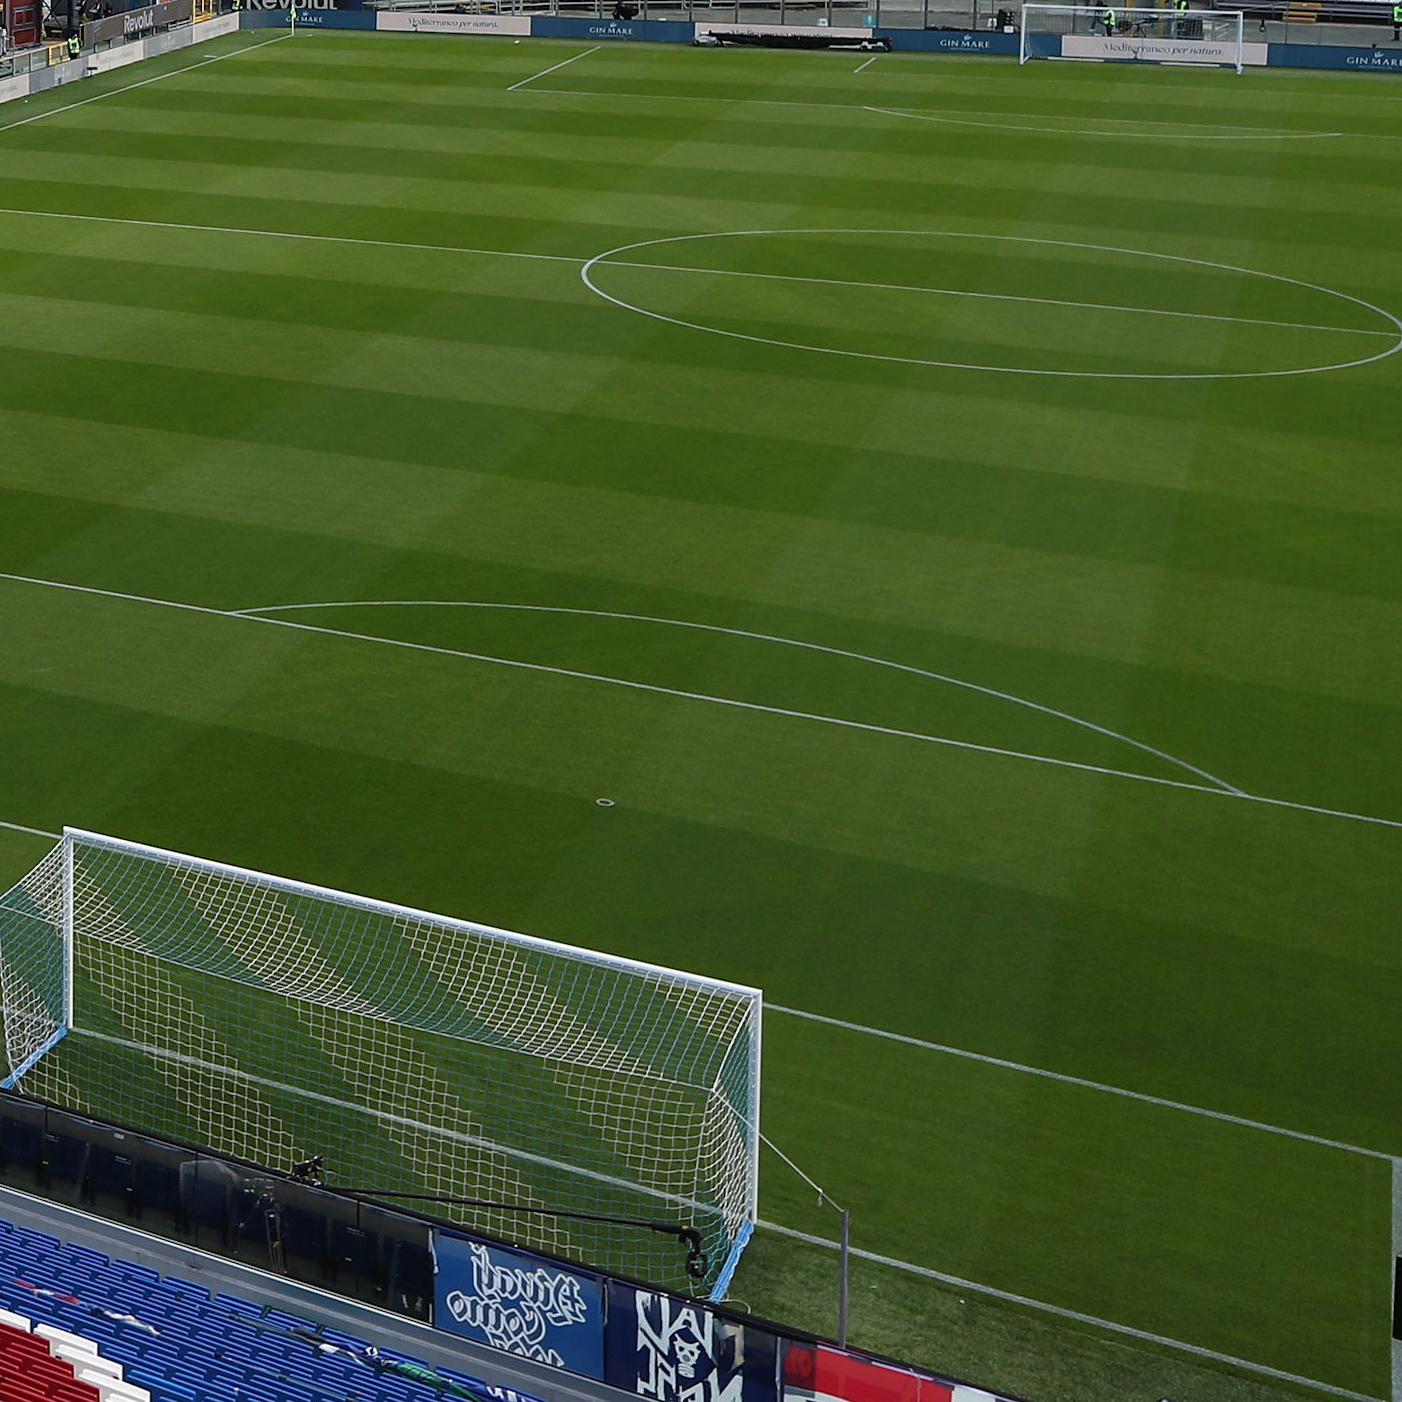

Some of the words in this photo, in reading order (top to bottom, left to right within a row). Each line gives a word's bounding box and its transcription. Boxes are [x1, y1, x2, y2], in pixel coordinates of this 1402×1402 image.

[124, 13, 154, 32] Revolut
[286, 15, 298, 24] GN
[589, 27, 607, 35] GIN
[609, 27, 633, 36] MARE
[940, 39, 961, 48] GIN
[963, 40, 990, 49] MARE
[1346, 56, 1369, 65] GIN
